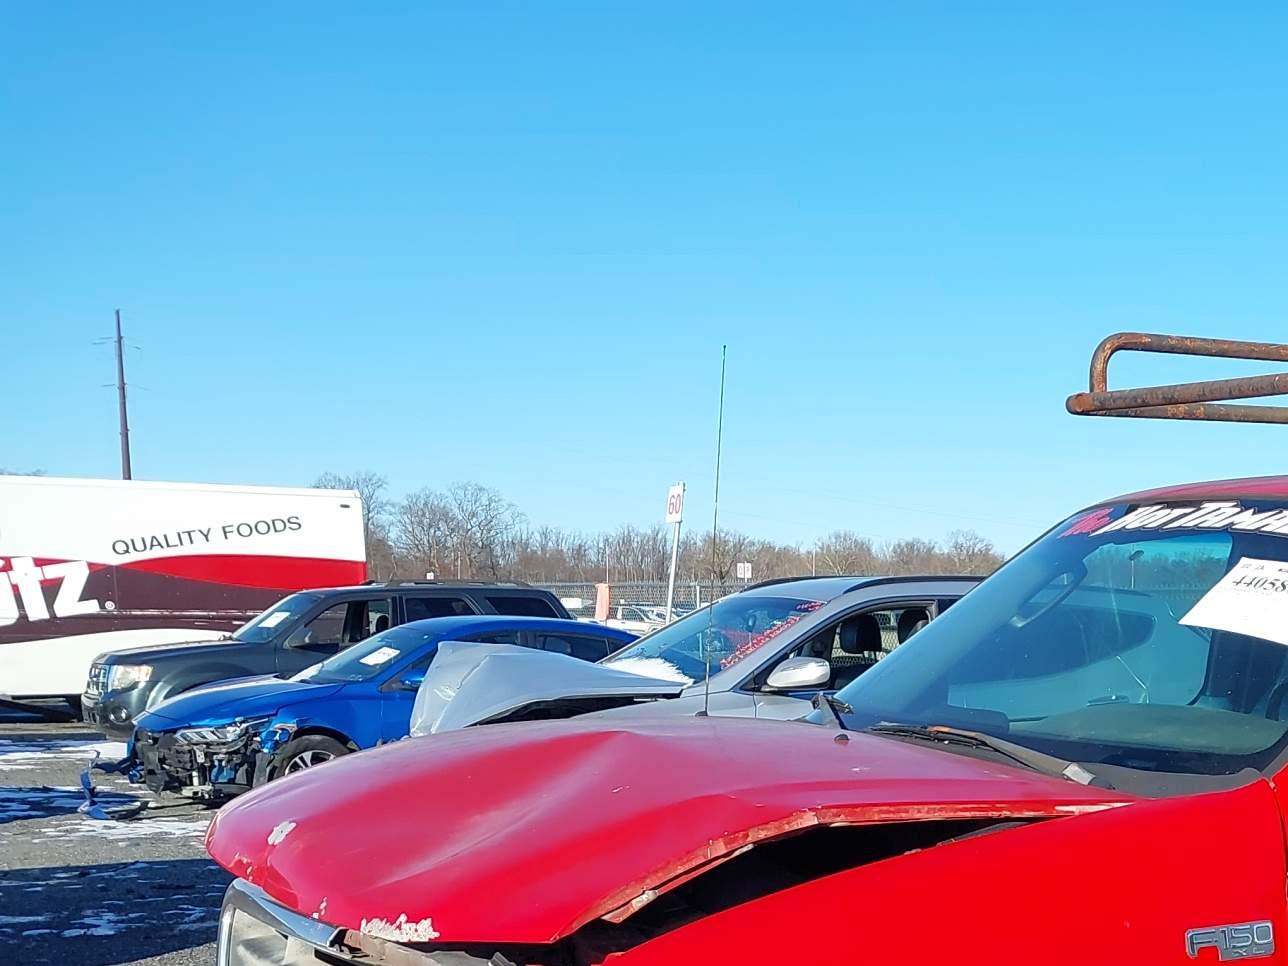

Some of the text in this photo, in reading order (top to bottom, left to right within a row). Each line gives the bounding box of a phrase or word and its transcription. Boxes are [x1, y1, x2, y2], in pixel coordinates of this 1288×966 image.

[669, 493, 681, 515] 60
[112, 515, 302, 556] QUALITY FOODS
